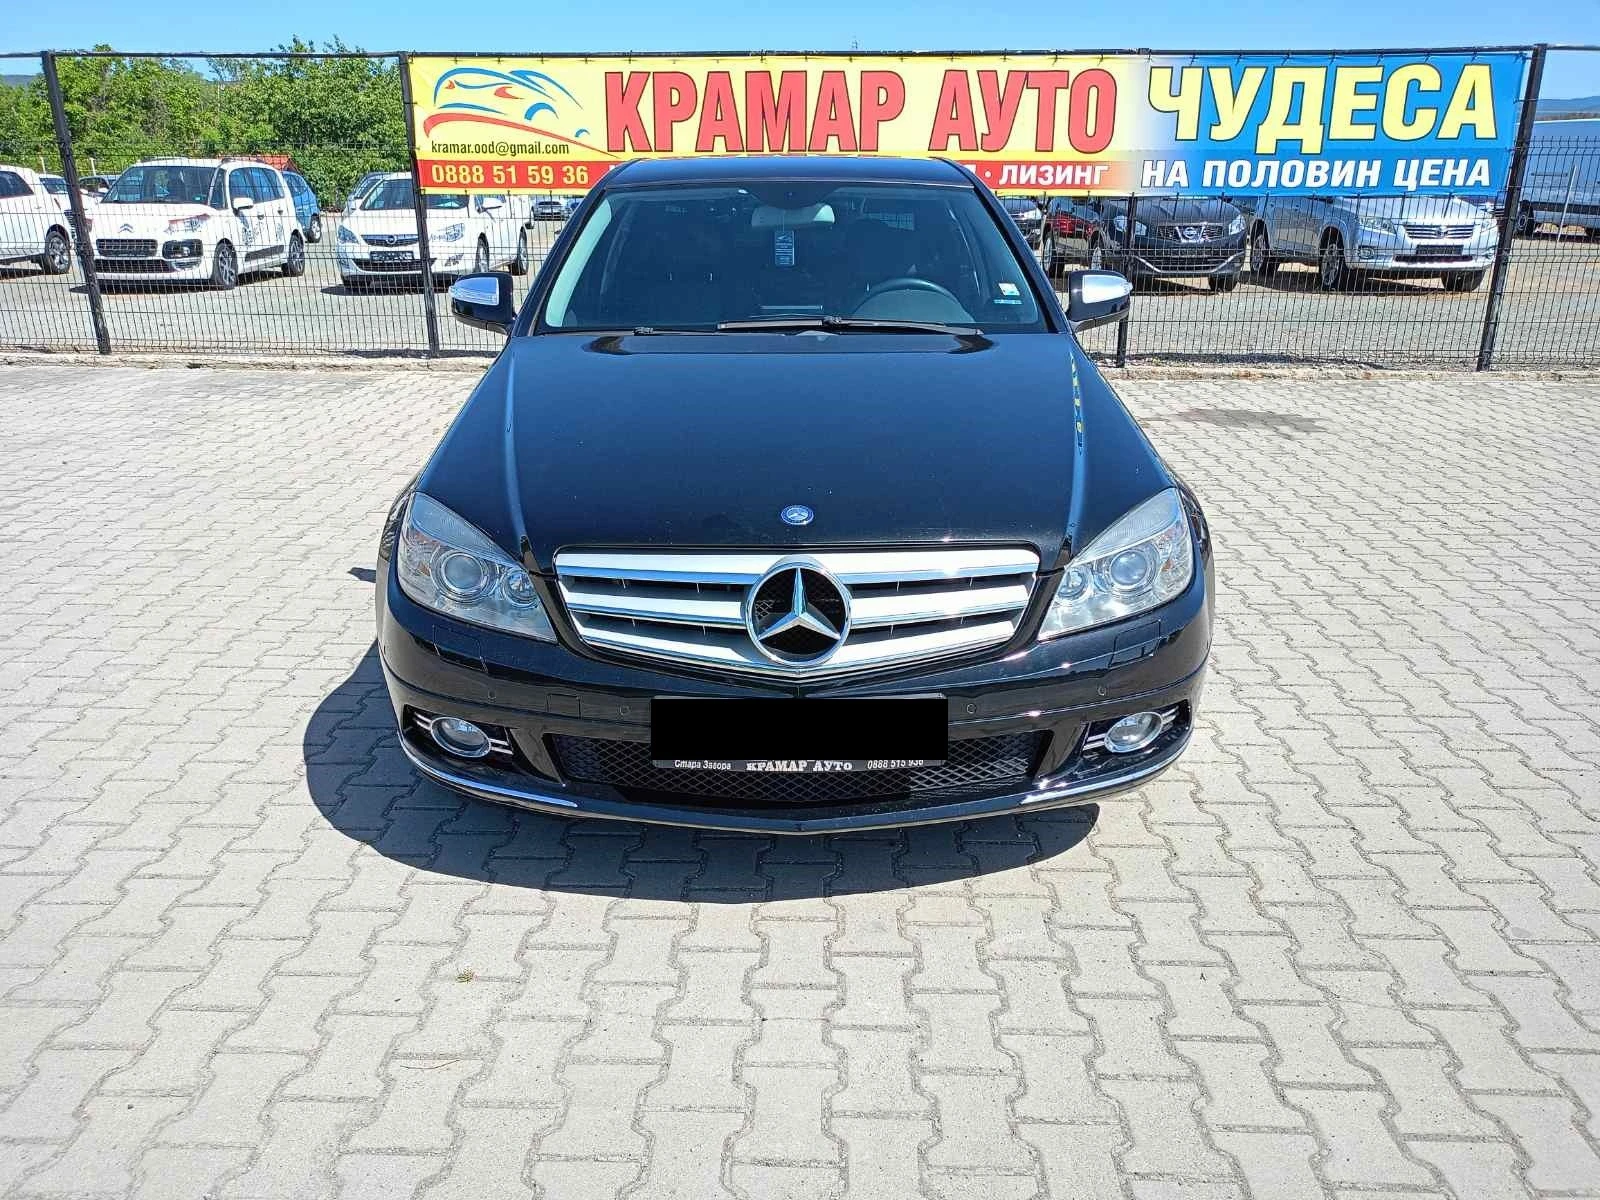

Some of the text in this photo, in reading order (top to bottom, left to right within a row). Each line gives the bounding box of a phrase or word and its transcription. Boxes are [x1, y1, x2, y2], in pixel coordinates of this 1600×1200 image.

[604, 68, 1118, 154] КРАМАР АУТО
[1148, 63, 1497, 155] ЧУДЕСА
[431, 140, 570, 156] kramar.ood@gmail.com
[431, 164, 589, 185] 0888 51 59 36
[999, 164, 1109, 186] ЛИЗИНГ
[1141, 159, 1491, 191] НА ПОЛОВИН ЦЕНА
